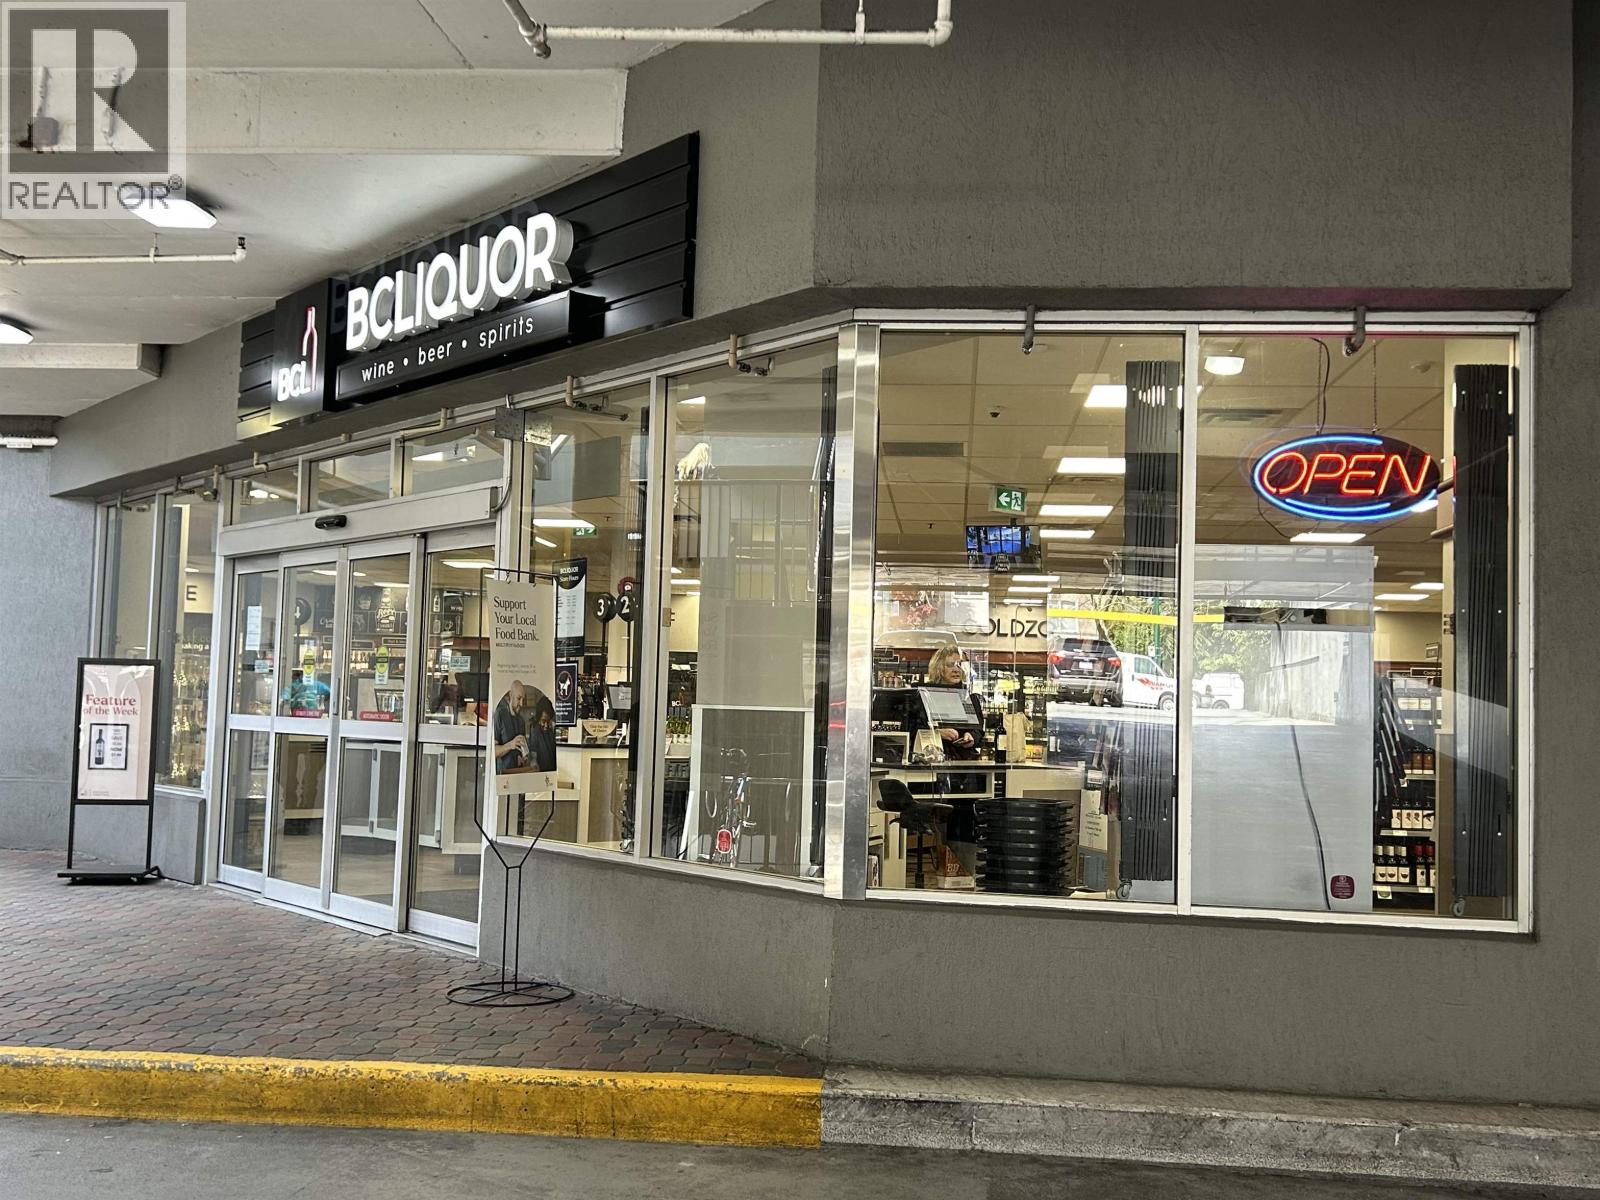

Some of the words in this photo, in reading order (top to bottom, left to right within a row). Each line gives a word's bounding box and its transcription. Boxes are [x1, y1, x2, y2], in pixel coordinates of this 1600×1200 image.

[345, 212, 572, 352] BCLIQUOR
[361, 359, 395, 383] wine
[418, 340, 453, 366] beer
[479, 314, 535, 349] spirits
[1261, 450, 1432, 498] OPEN
[493, 596, 527, 612] Support
[597, 598, 605, 617] 3
[620, 596, 630, 615] 2
[494, 612, 514, 625] Your
[515, 613, 537, 626] Local
[495, 627, 516, 640] Food
[85, 693, 137, 708] Feature
[83, 706, 94, 716] of
[95, 706, 110, 716] the
[111, 706, 139, 717] Week
